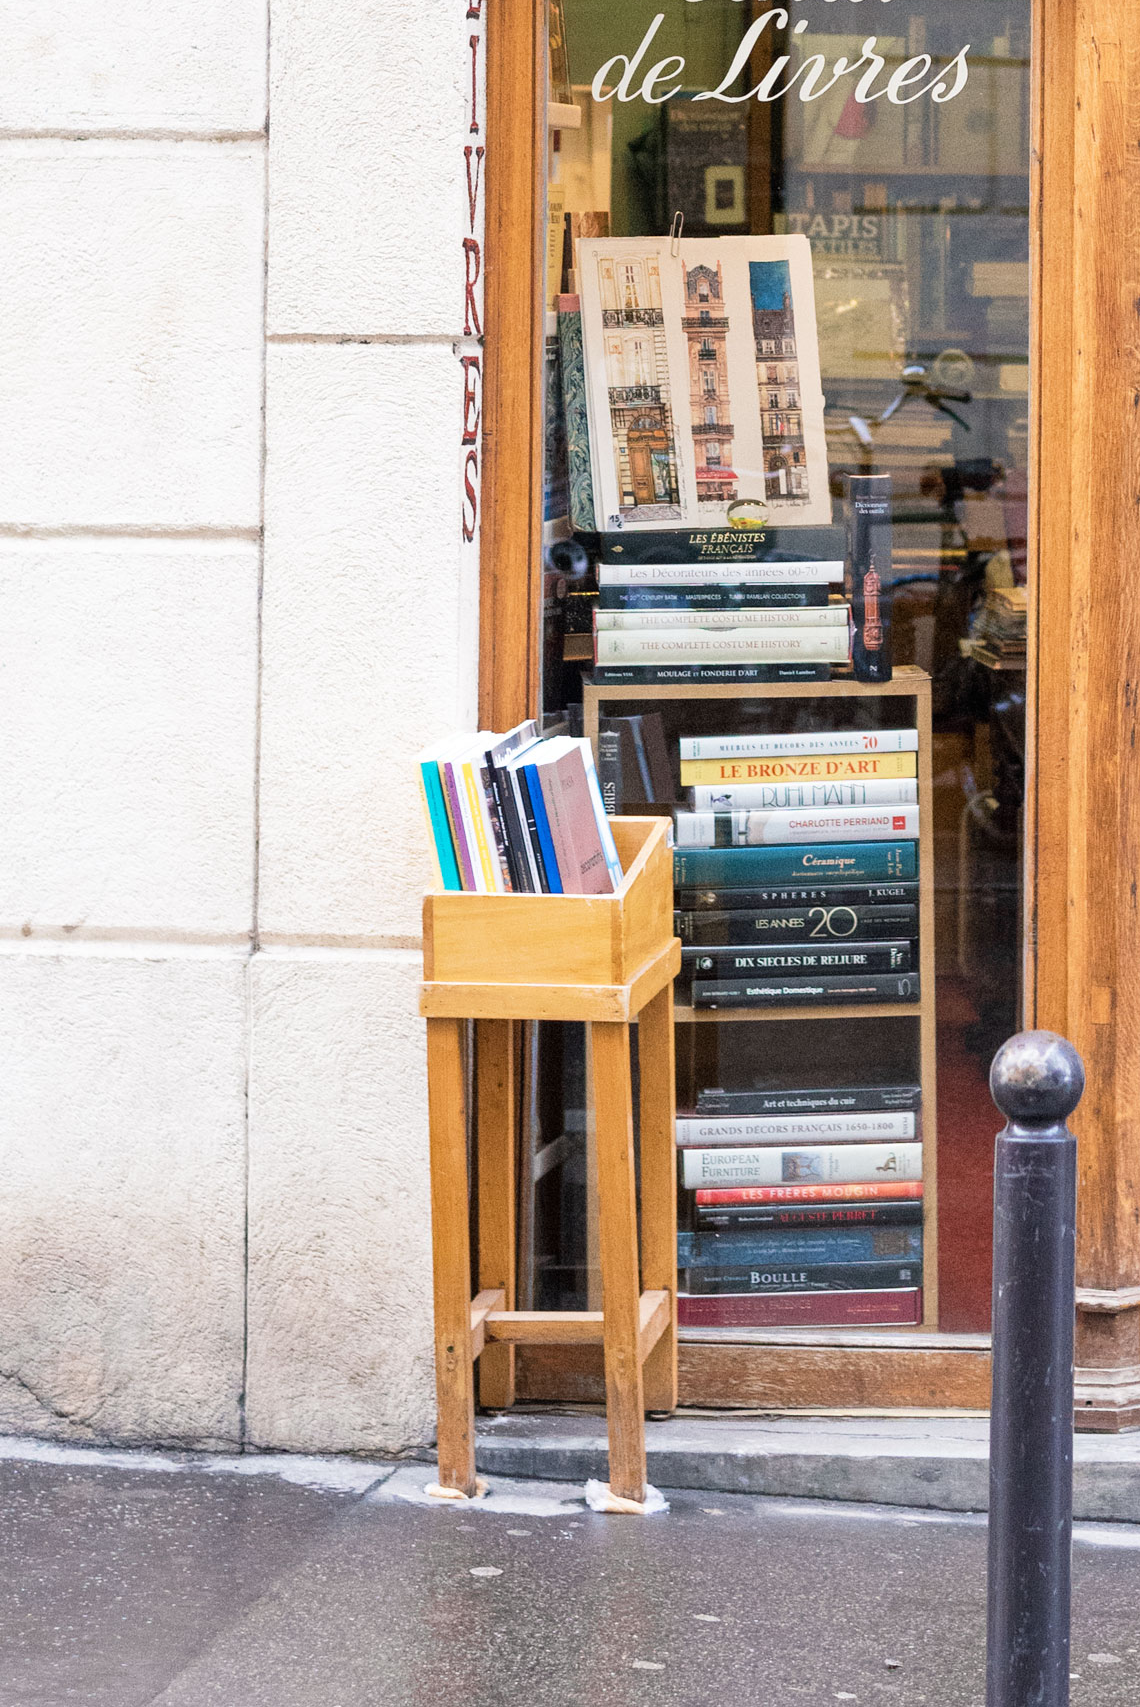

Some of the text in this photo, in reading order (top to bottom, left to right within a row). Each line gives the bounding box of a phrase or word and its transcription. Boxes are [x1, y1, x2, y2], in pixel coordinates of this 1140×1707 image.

[592, 8, 971, 103] de Livres
[788, 213, 879, 238] TAPIS
[855, 501, 889, 509] Dictionnaire
[690, 532, 766, 544] LES ÉBÉNISTES
[701, 544, 754, 555] FRANÇAIS
[629, 567, 818, 579] Les Décorateurs des années 60-70
[640, 616, 660, 625] THE
[661, 615, 710, 625] COMPLETE
[711, 614, 758, 624] COSTUME
[760, 613, 801, 623] HISTORY
[640, 642, 660, 650] THE
[661, 641, 710, 650] COMPLETE
[711, 640, 759, 650] COSTUME
[760, 640, 802, 649] HISTORY
[657, 670, 692, 678] MOULAGE
[700, 670, 737, 678] FONDERIE
[738, 669, 759, 677] D'ART
[720, 743, 757, 752] MEUBLES
[774, 742, 805, 750] DECORS
[809, 741, 825, 749] DES
[862, 736, 878, 750] 70
[719, 759, 881, 780] LE BRONZE D'ART
[604, 782, 616, 816] BRES
[762, 783, 866, 808] RUHLMANN
[788, 818, 842, 829] CHARLOTTE
[843, 817, 890, 828] PERRIAND
[802, 854, 857, 870] Céramique
[762, 890, 827, 900] SPHERES
[876, 888, 906, 897] KUGEL
[756, 919, 770, 929] LES
[808, 906, 858, 937] 20
[735, 955, 868, 967] DIX SIECLES DE RELIURE
[746, 987, 783, 996] Esthétique
[783, 985, 824, 995] Domestique
[762, 1100, 776, 1108] Art
[787, 1098, 827, 1108] techniques
[840, 1097, 857, 1105] cuir
[699, 1121, 894, 1137] GRANDS DÉCORS FRANÇAIS 1650-1800
[702, 1153, 760, 1166] EUROPEAN
[702, 1167, 760, 1178] FURNITURE
[742, 1186, 879, 1200] LES FRÈRES MOUGIN
[832, 1210, 878, 1222] PERRET
[750, 1271, 808, 1284] BOULLE
